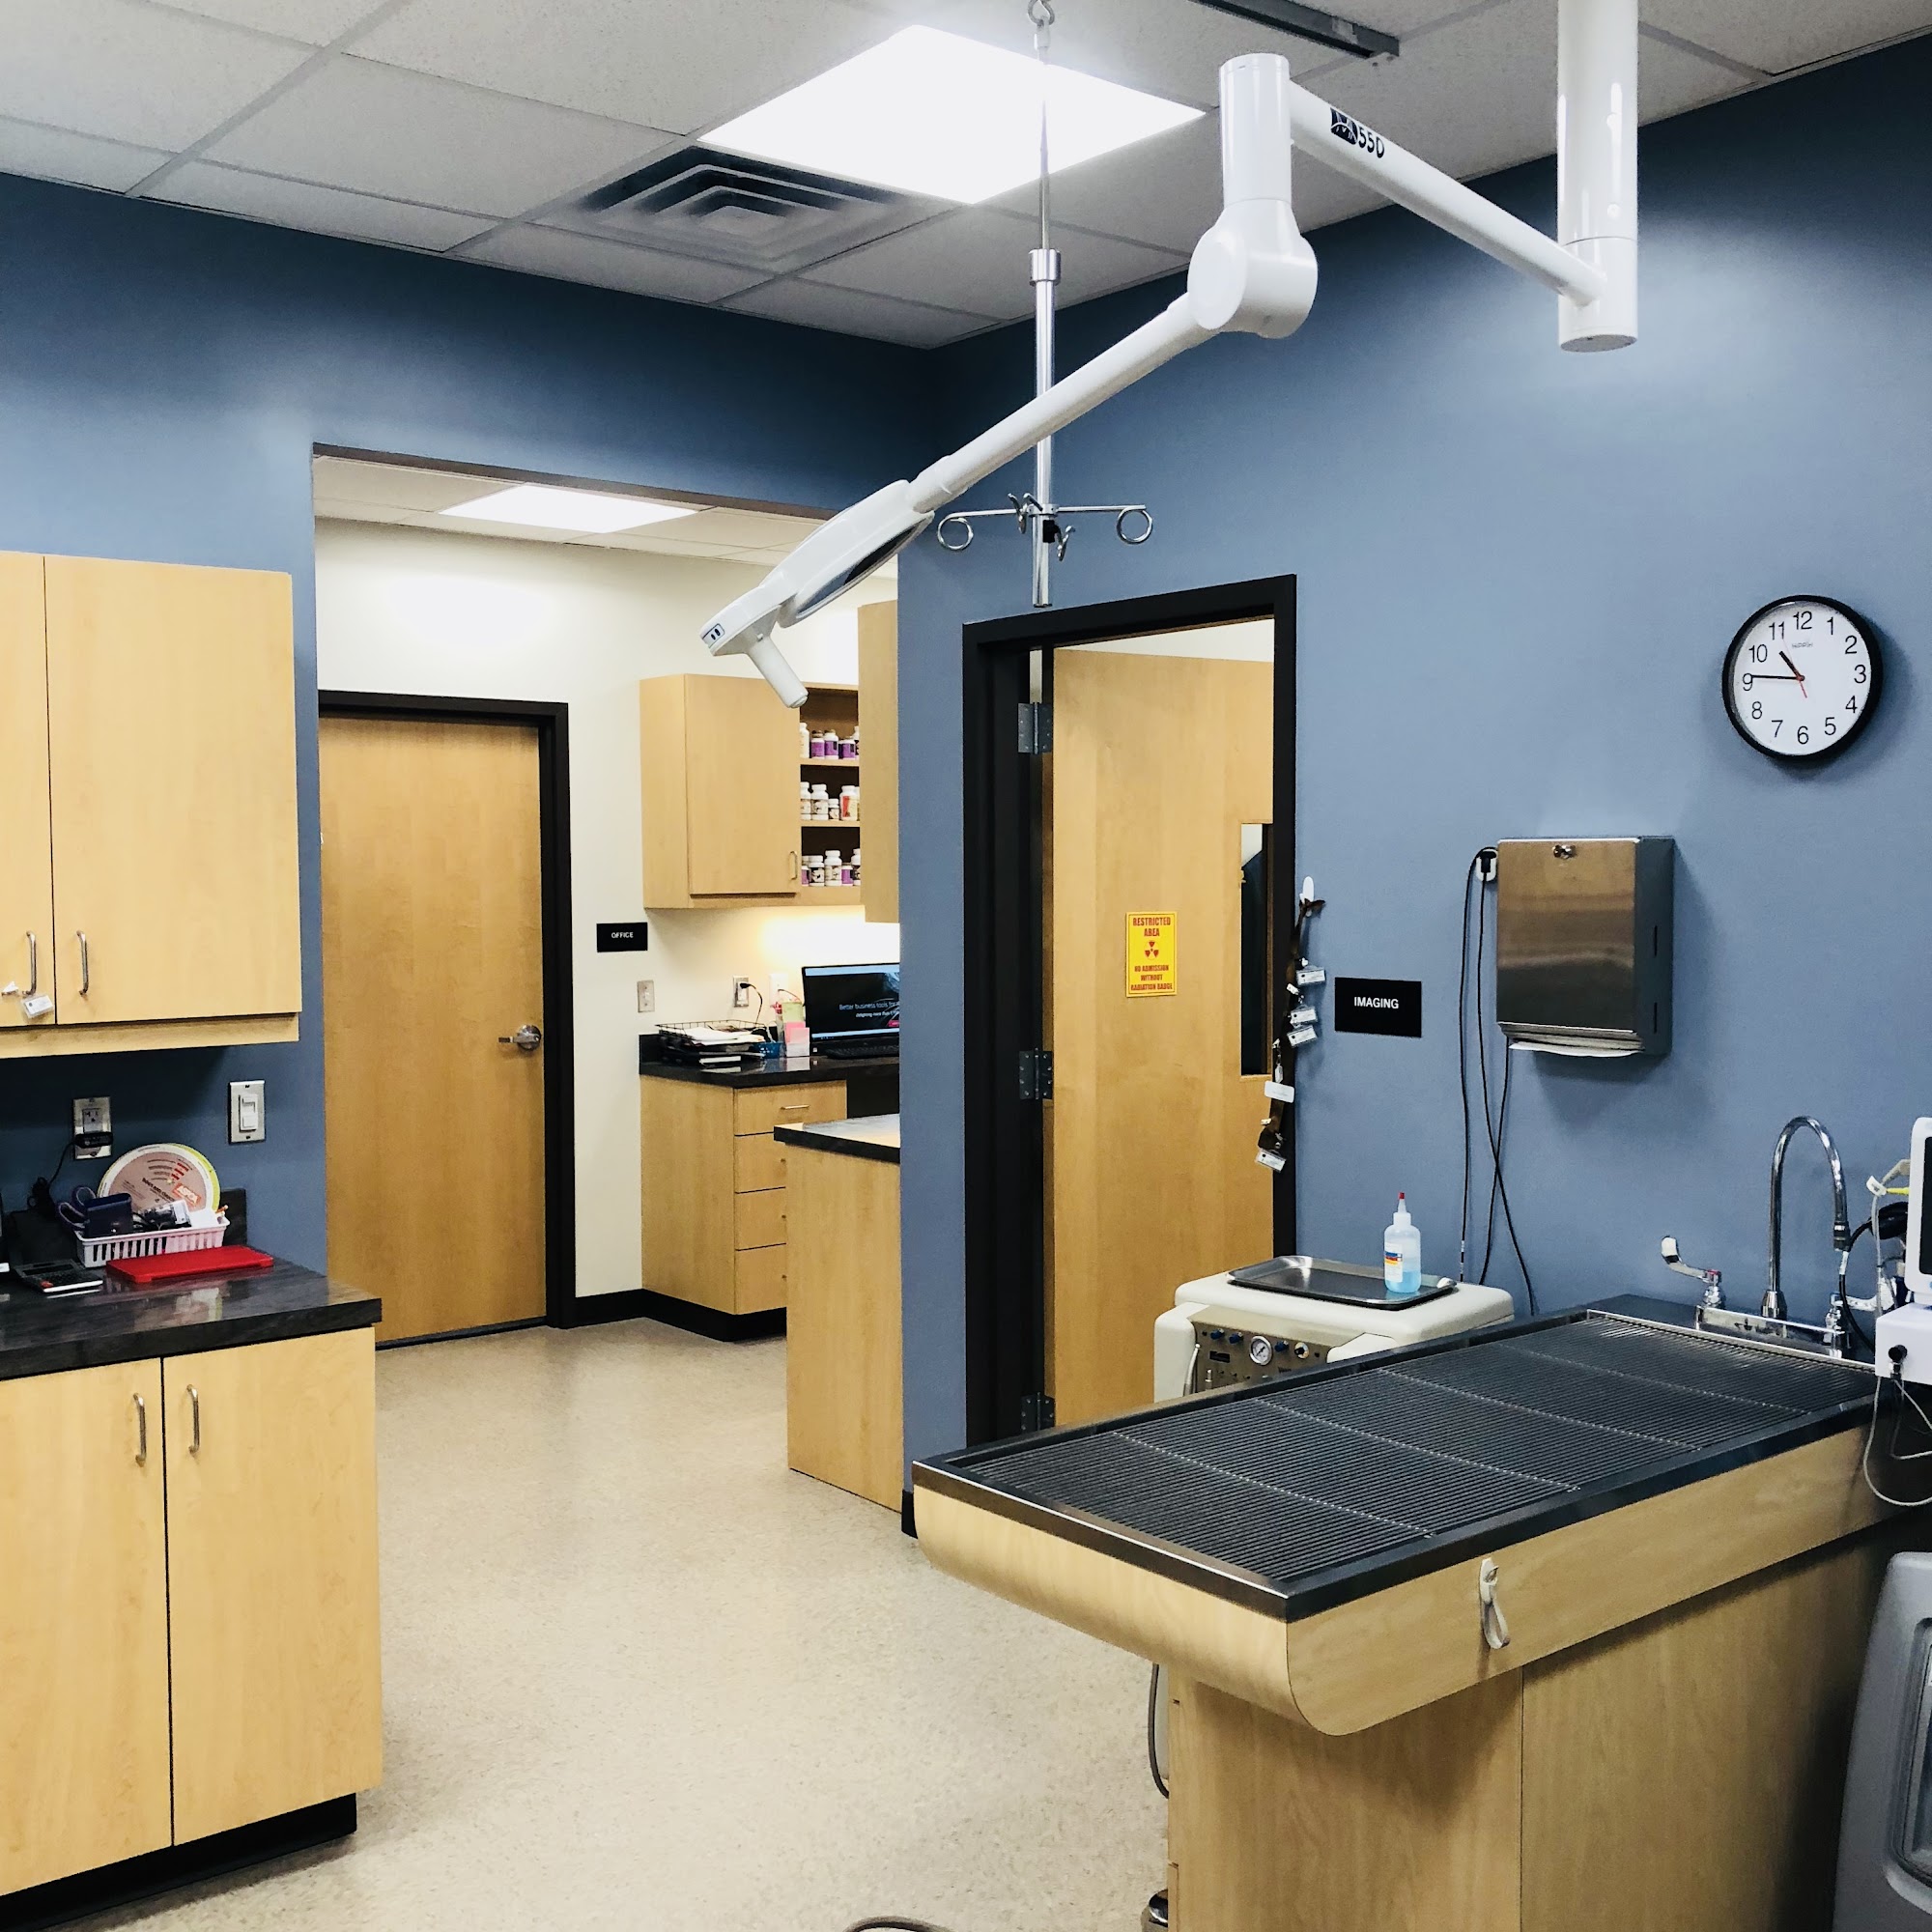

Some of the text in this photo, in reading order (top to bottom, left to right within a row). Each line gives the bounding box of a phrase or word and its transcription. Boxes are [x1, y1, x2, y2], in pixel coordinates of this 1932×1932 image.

[1793, 611, 1812, 630] 12
[1827, 616, 1834, 636] 1
[1769, 621, 1785, 640] 11
[1748, 643, 1768, 664] 10
[1845, 635, 1858, 655] 2
[1742, 672, 1753, 692] 9
[1854, 664, 1867, 684] 3
[1751, 701, 1763, 720] 8
[1845, 696, 1858, 714] 4
[1771, 720, 1783, 738] 7
[1798, 725, 1809, 745] 6
[1825, 717, 1836, 735] 5
[1133, 918, 1171, 926] RESTRICTED
[1144, 928, 1160, 937] AREA
[1353, 996, 1400, 1009] IMAGING
